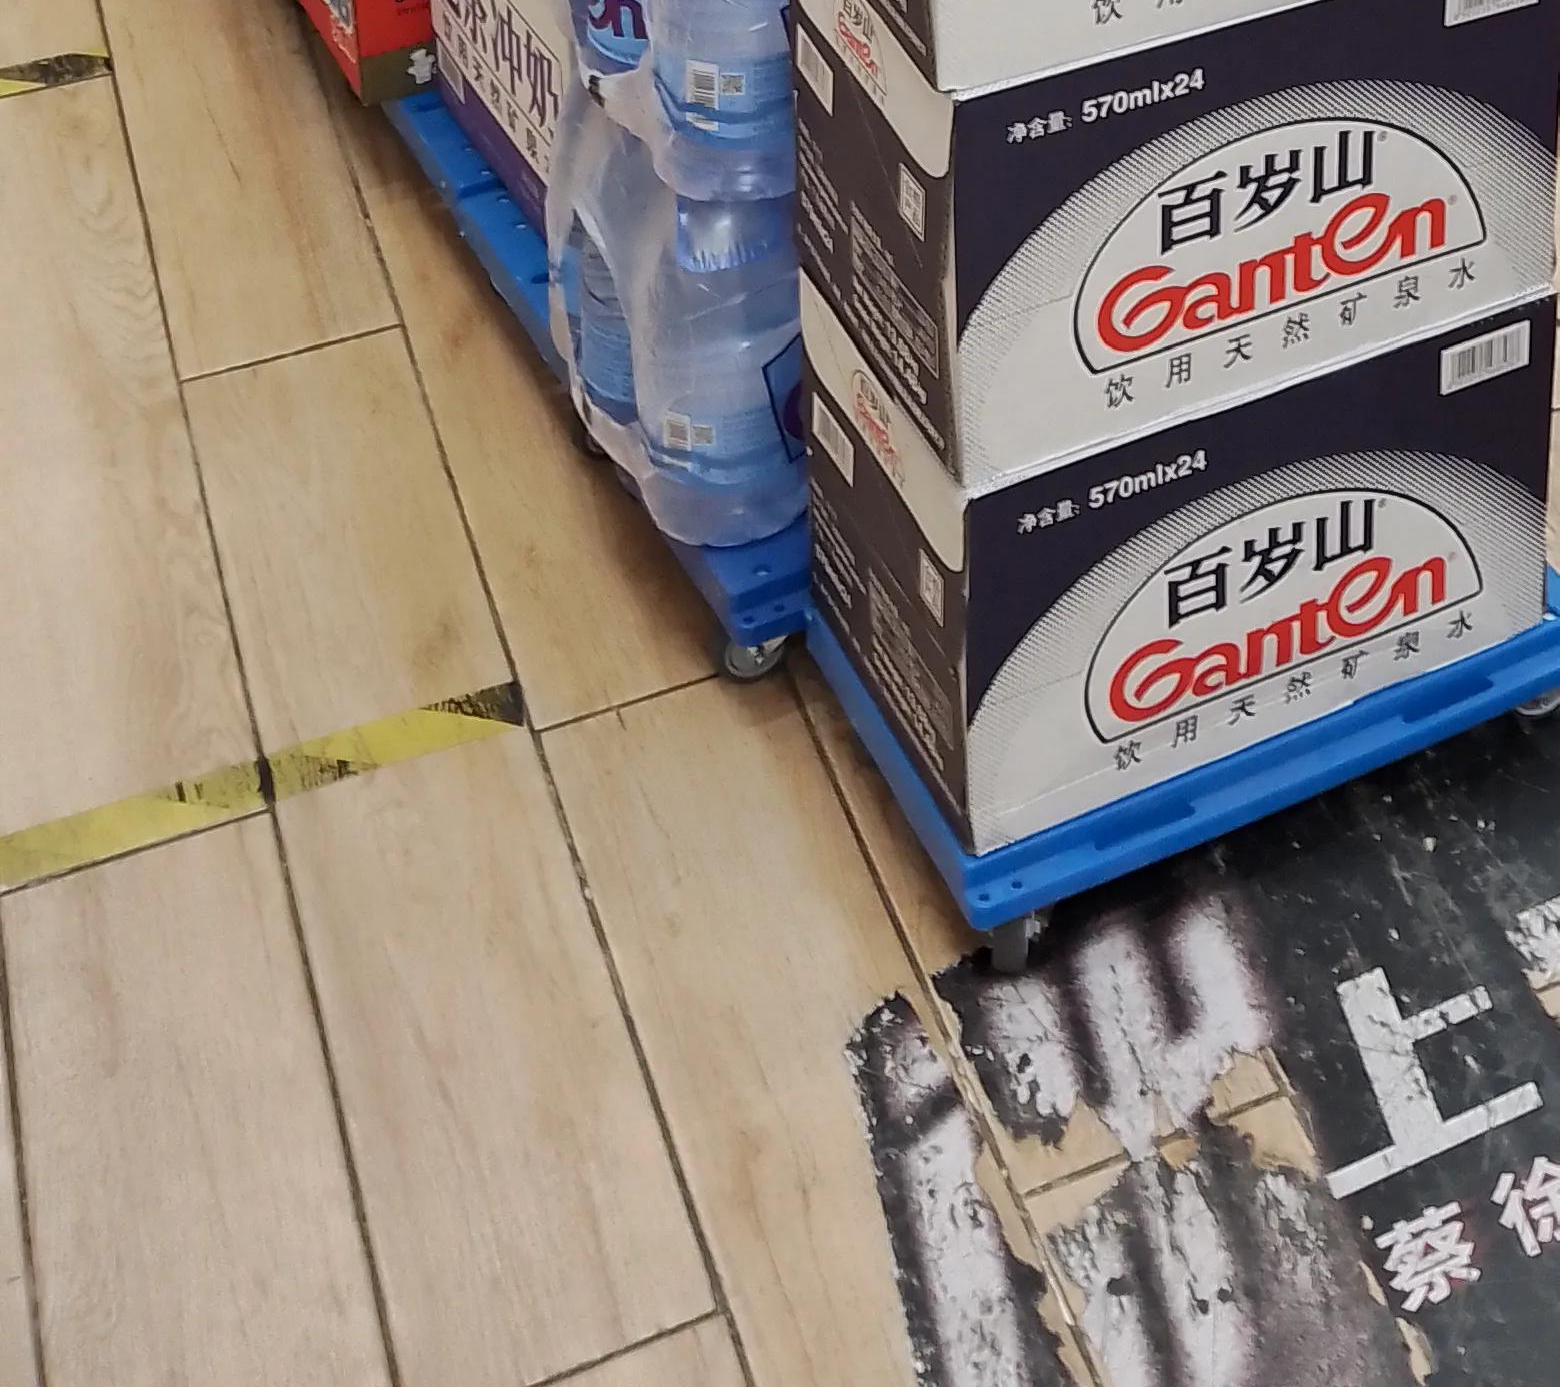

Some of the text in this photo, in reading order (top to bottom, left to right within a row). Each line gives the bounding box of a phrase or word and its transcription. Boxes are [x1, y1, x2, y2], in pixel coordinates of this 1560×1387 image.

[1080, 68, 1206, 126] 570mlx24
[1158, 129, 1378, 253] 百岁山
[1094, 192, 1449, 354] Ganten
[1104, 257, 1477, 409] 饮用天然矿泉水
[1087, 448, 1209, 512] 570mlx24
[1166, 498, 1378, 629] 百岁山
[1108, 553, 1449, 723] Ganten
[1113, 610, 1475, 773] 饮用天然矿泉水
